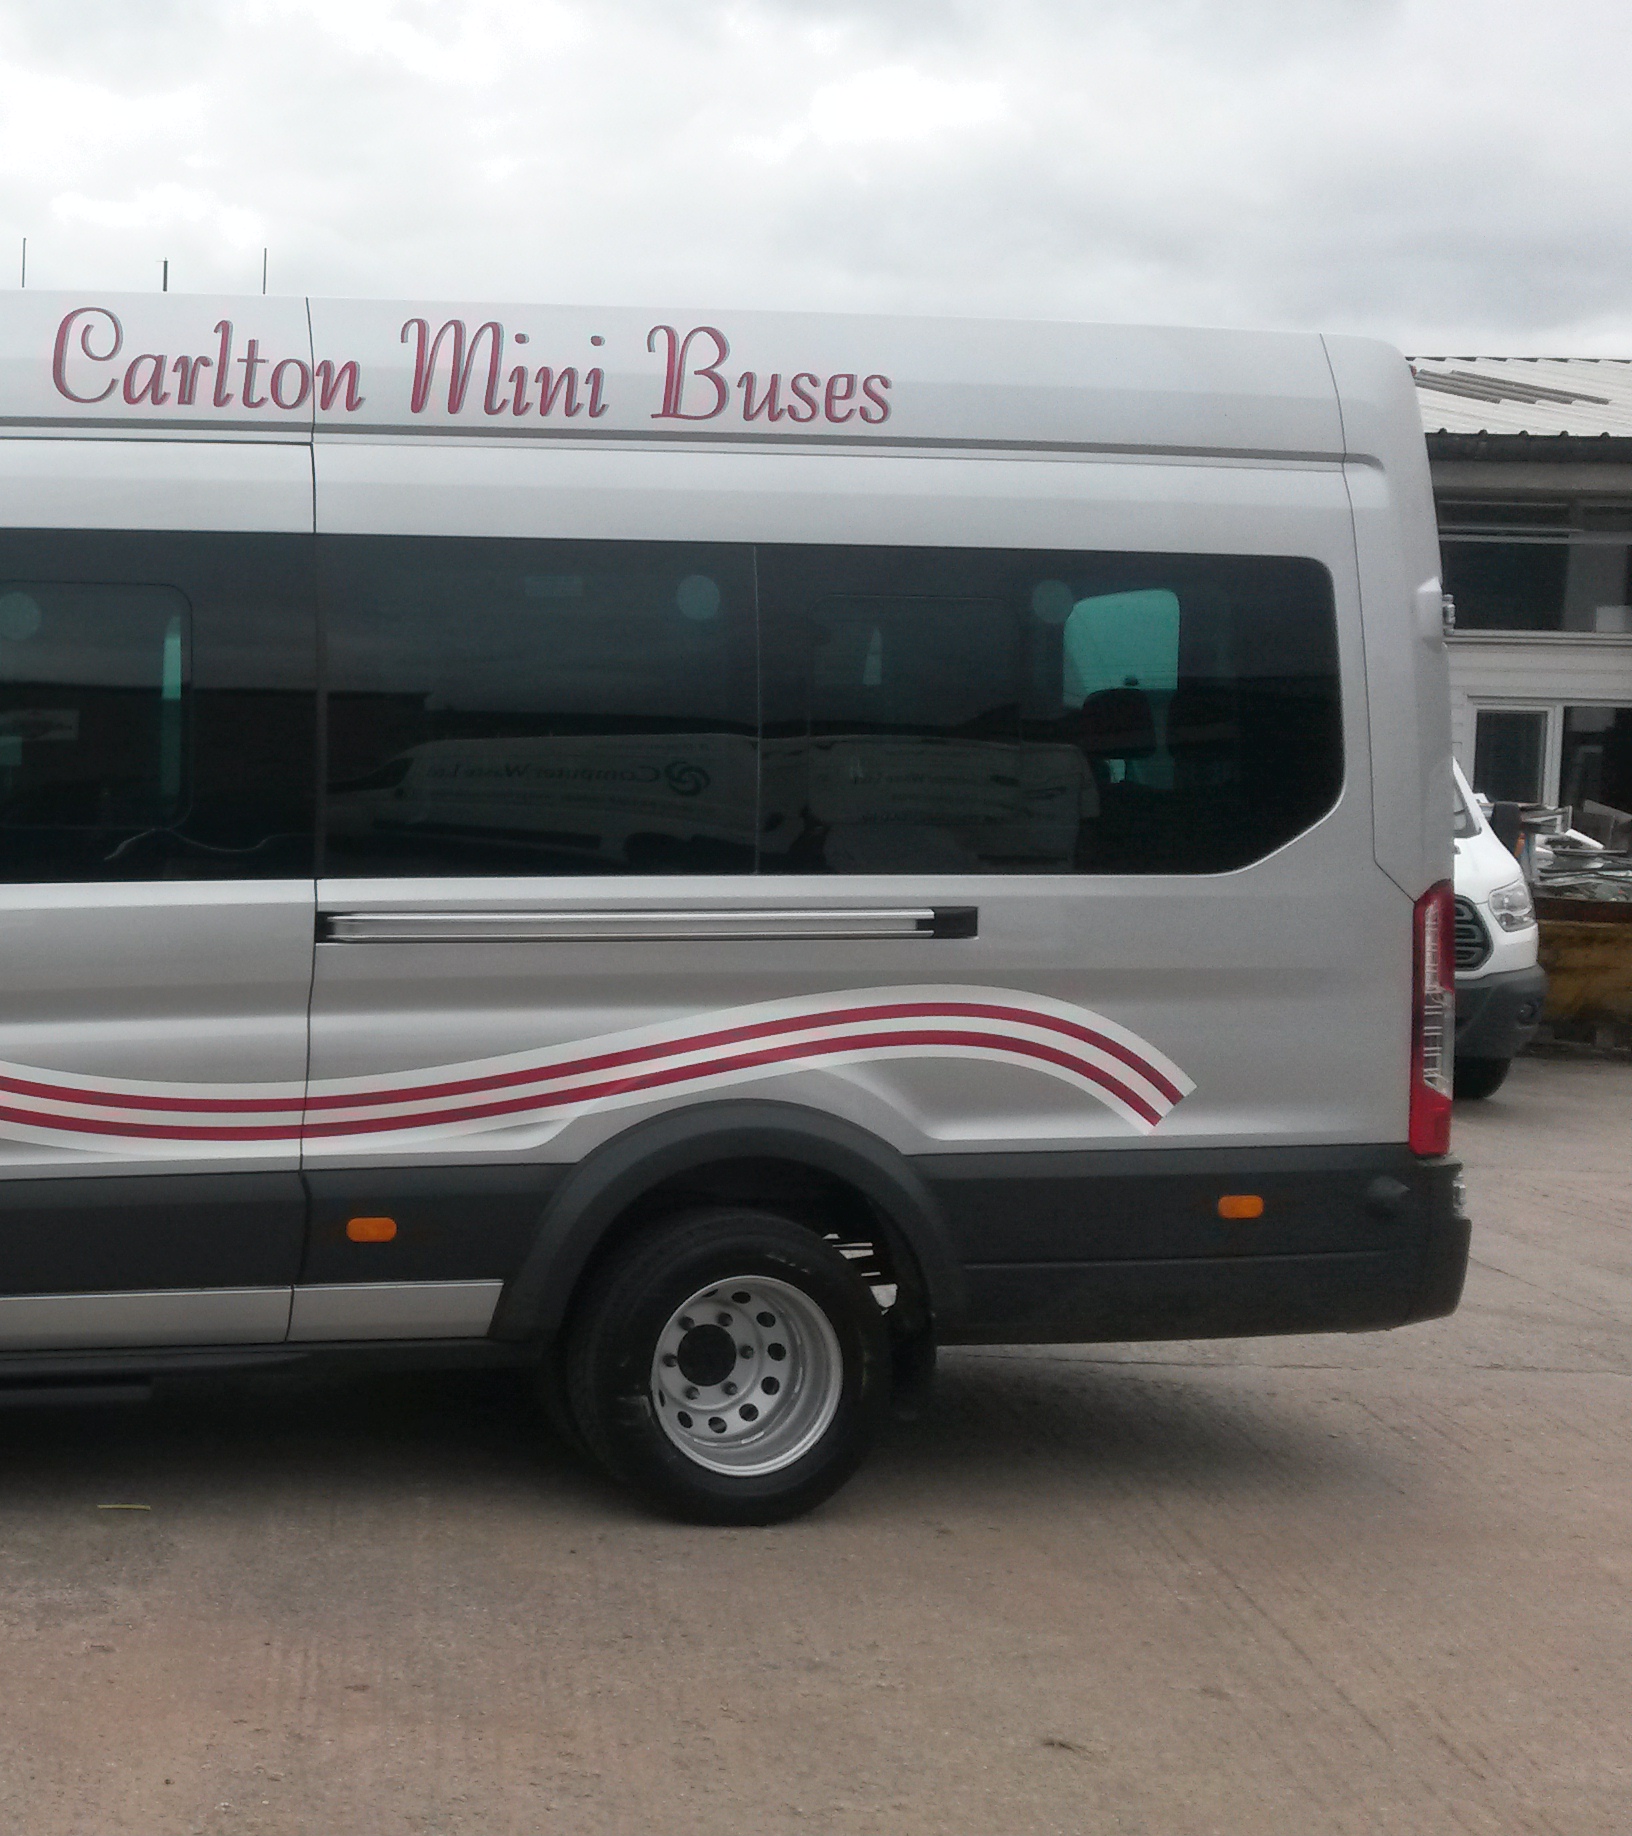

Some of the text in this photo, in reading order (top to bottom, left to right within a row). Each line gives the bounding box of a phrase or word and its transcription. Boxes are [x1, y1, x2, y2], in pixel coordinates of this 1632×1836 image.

[52, 306, 893, 424] Carlton Mini Buses
